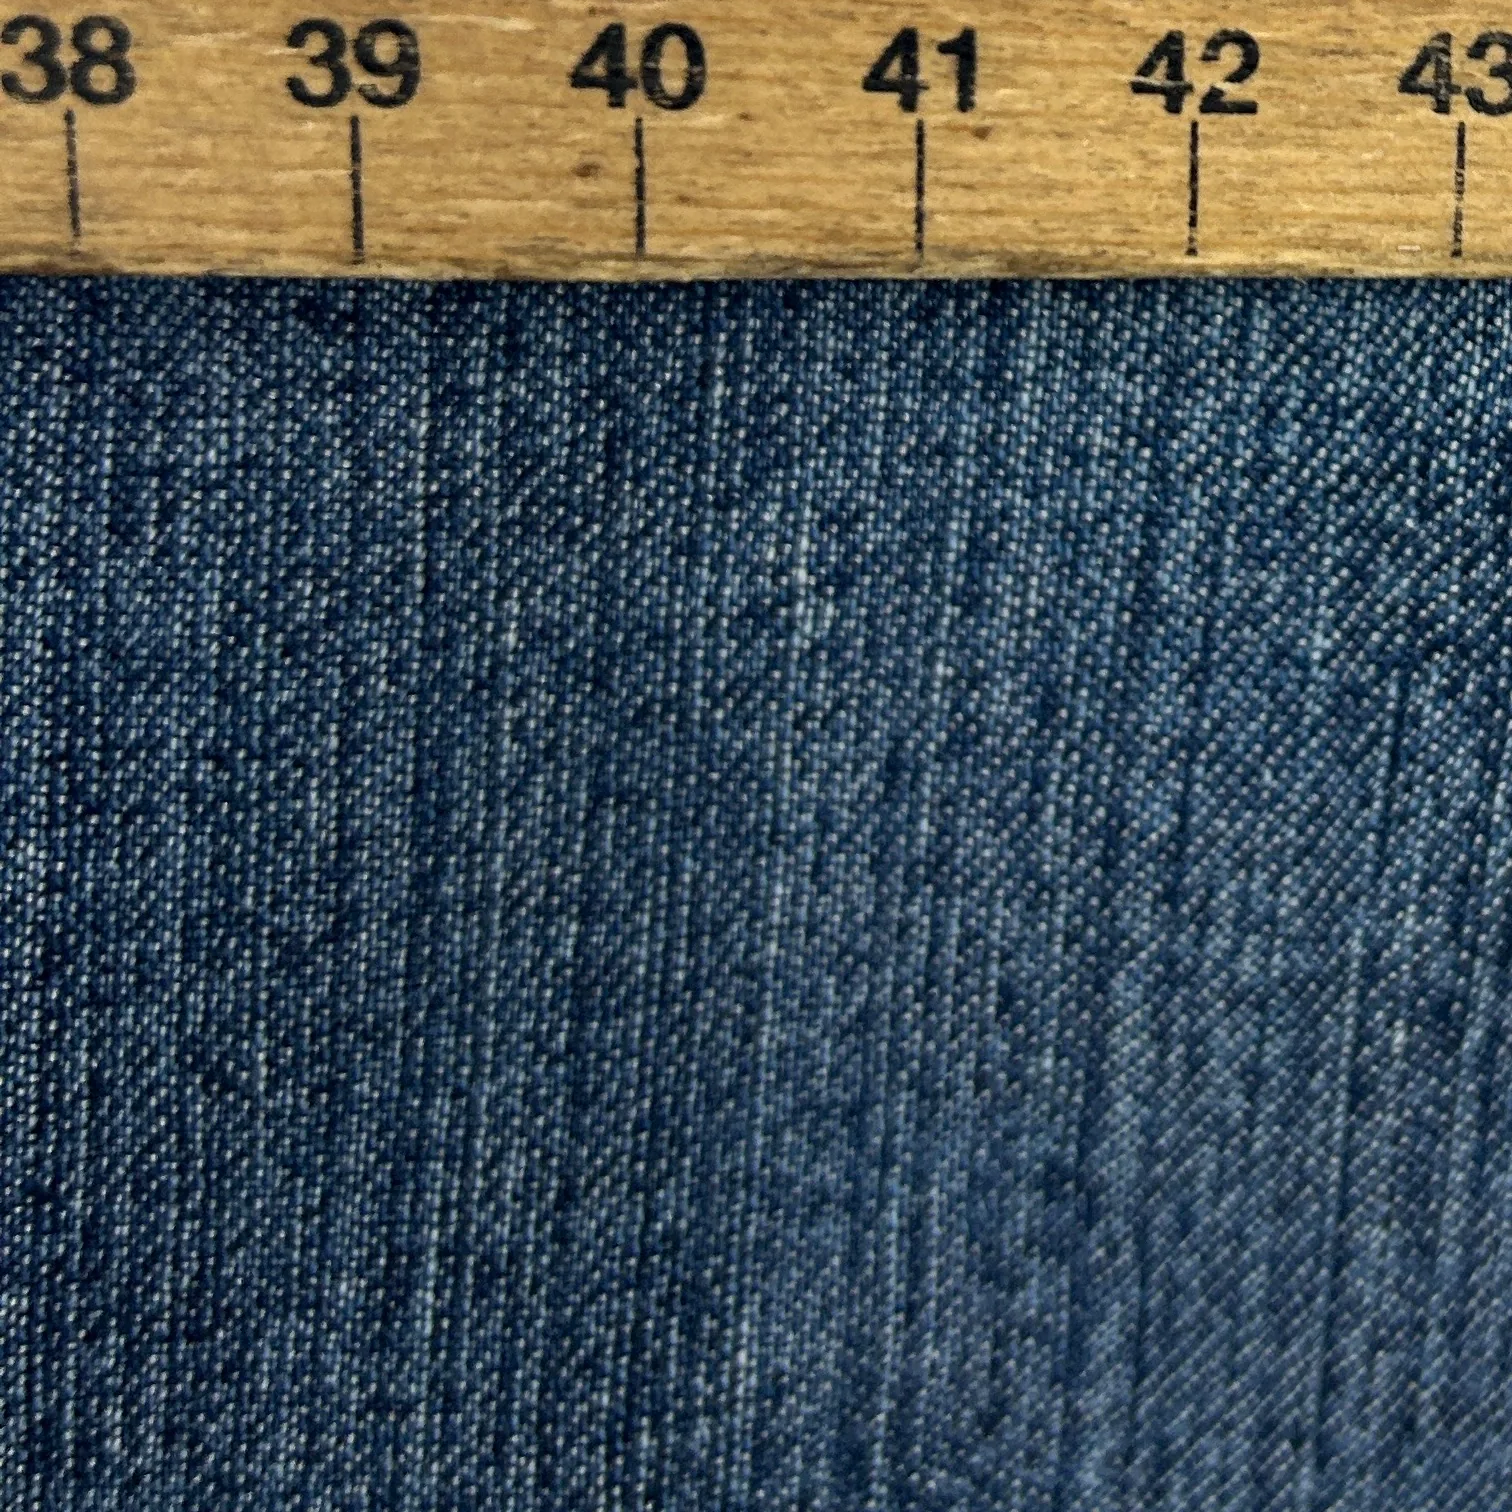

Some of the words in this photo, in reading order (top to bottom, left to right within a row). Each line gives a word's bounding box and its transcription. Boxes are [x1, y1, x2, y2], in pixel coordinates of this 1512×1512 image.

[0, 13, 136, 106] 38
[284, 17, 422, 109] 39
[566, 21, 707, 111] 40
[861, 26, 978, 115] 41
[1129, 29, 1260, 116] 42
